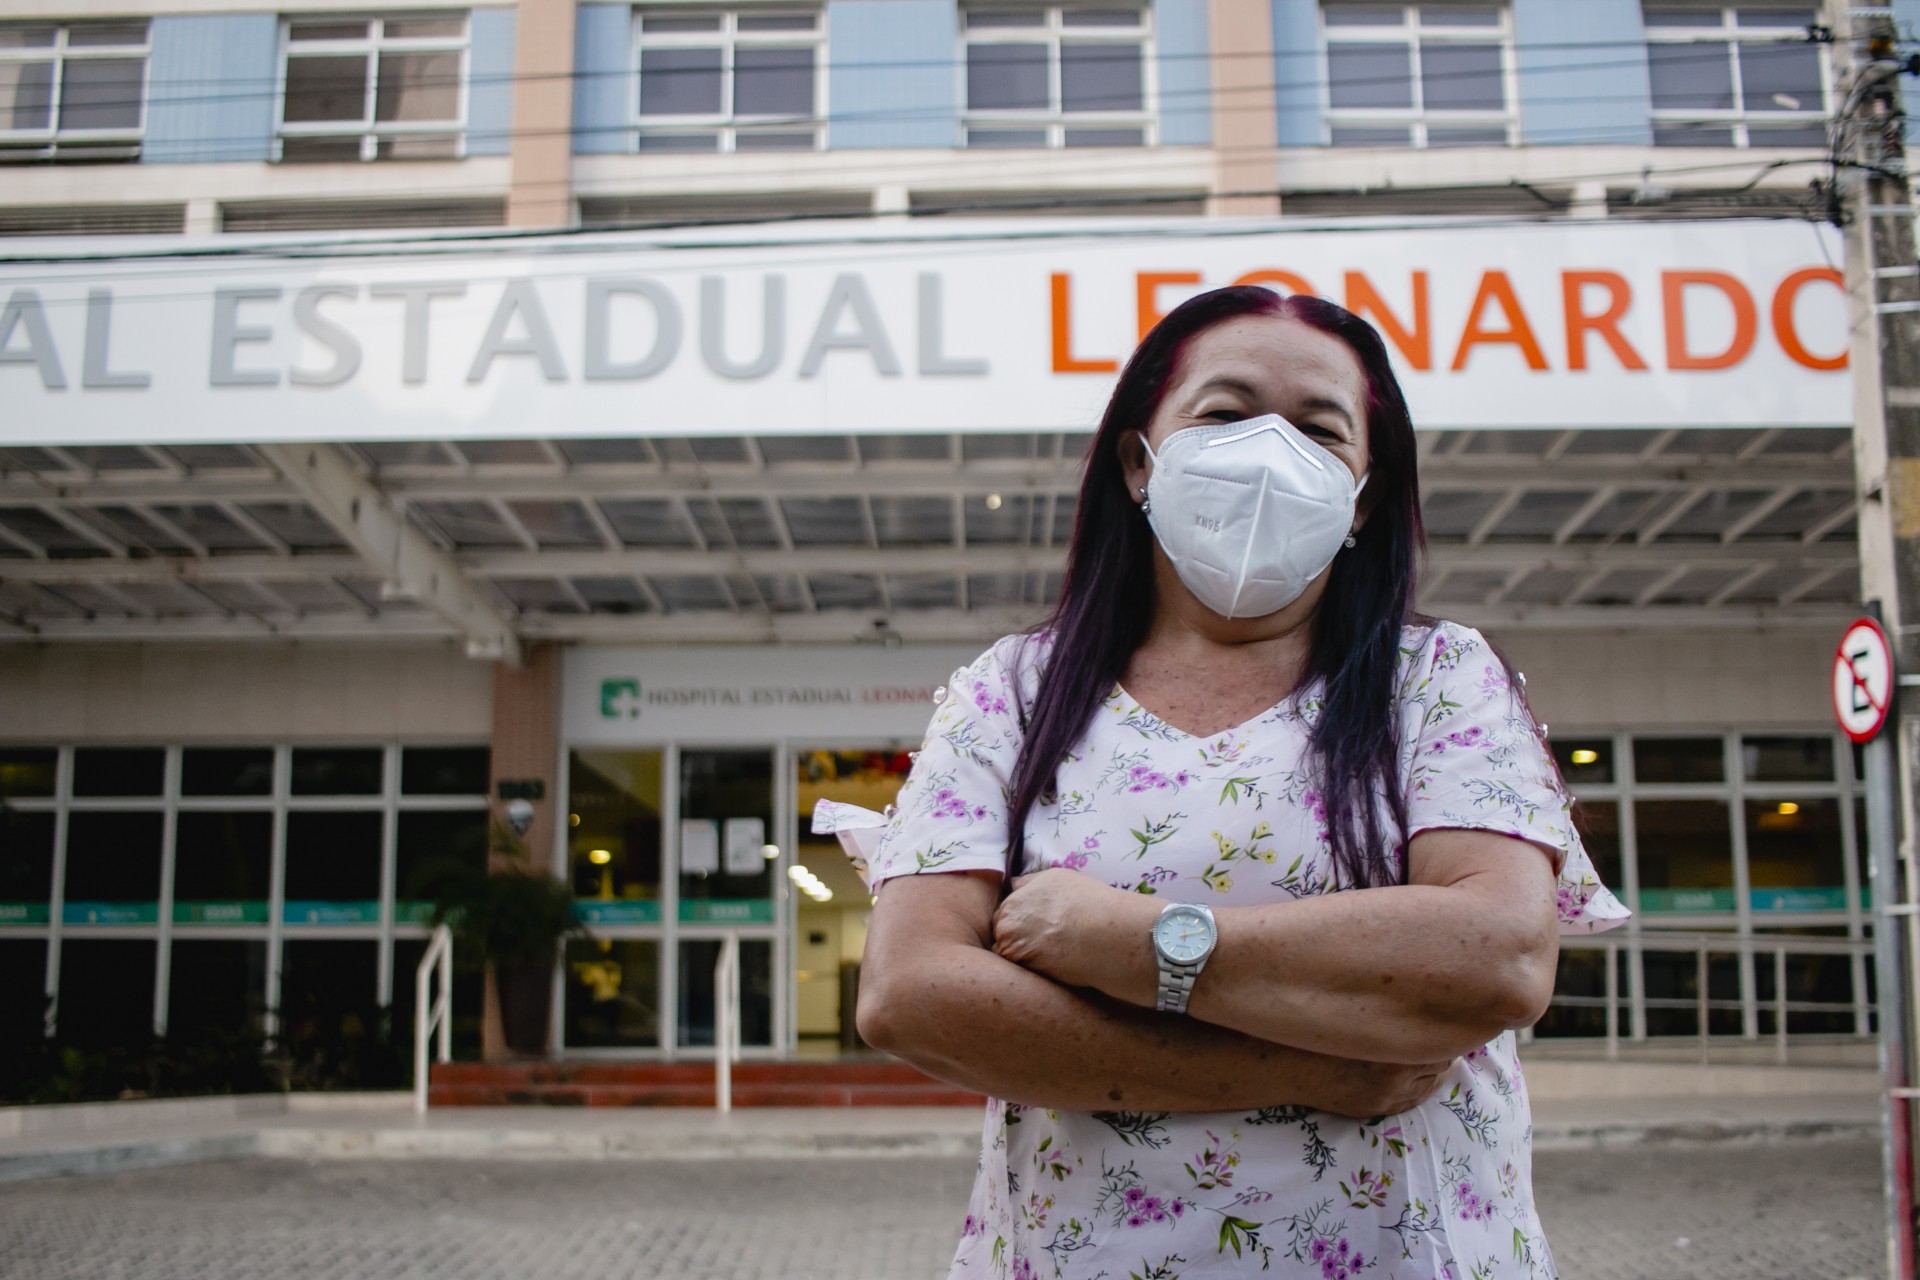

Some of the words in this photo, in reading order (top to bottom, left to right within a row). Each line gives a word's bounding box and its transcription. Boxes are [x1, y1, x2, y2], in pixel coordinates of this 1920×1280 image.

[208, 270, 991, 388] ESTADUAL
[1051, 267, 1849, 373] LNARDO
[648, 687, 741, 705] HOSPITAL
[752, 687, 851, 704] ESTADUAL
